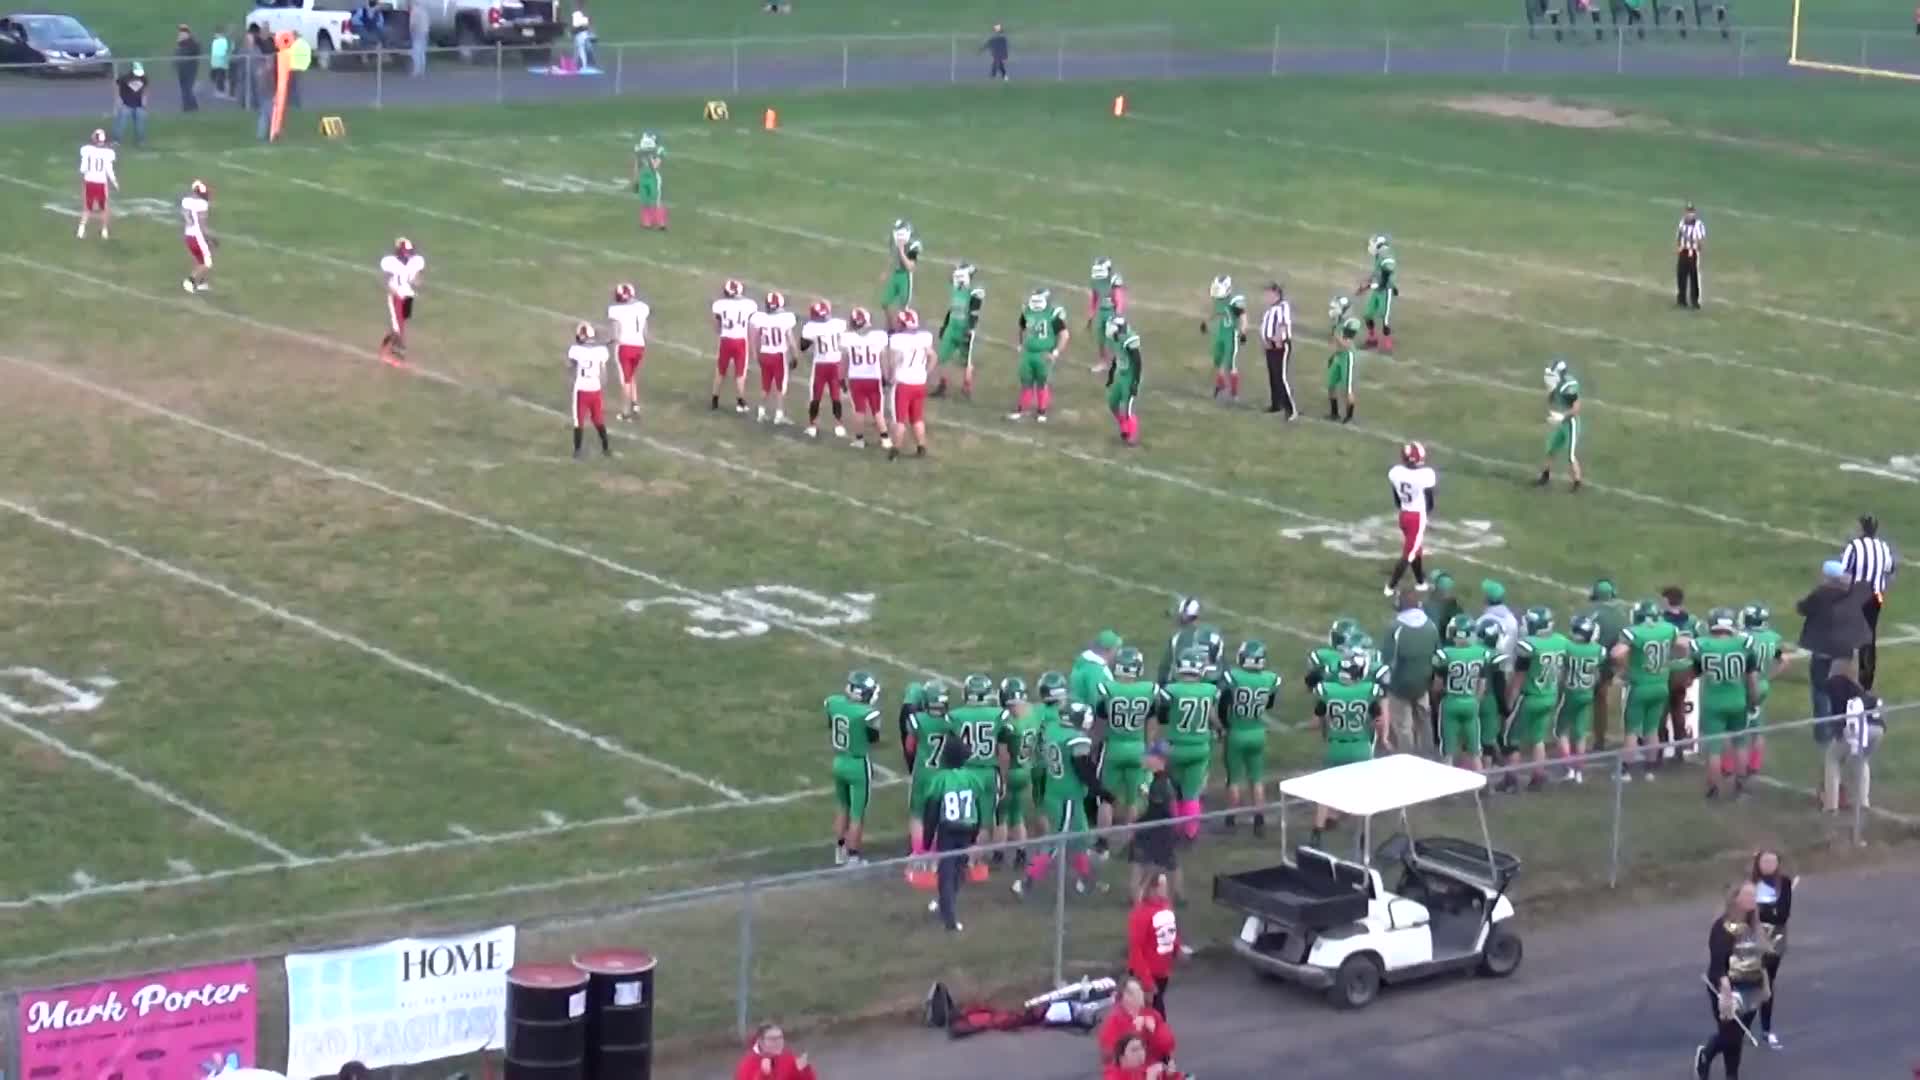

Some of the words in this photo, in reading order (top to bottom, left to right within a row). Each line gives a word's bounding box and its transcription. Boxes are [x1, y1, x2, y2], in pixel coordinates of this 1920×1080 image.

[851, 345, 878, 367] 66
[1400, 481, 1413, 504] 5
[622, 584, 875, 640] 30
[1447, 660, 1484, 694] 22
[1567, 656, 1599, 689] 15
[1701, 652, 1746, 683] 50
[1109, 696, 1150, 732] 62
[1176, 697, 1211, 733] 71
[1233, 686, 1269, 719] 82
[1326, 699, 1369, 732] 63
[832, 714, 849, 750] 6
[944, 789, 973, 821] 87
[402, 941, 503, 982] HOME
[27, 991, 127, 1033] Mark
[131, 983, 249, 1017] Porter
